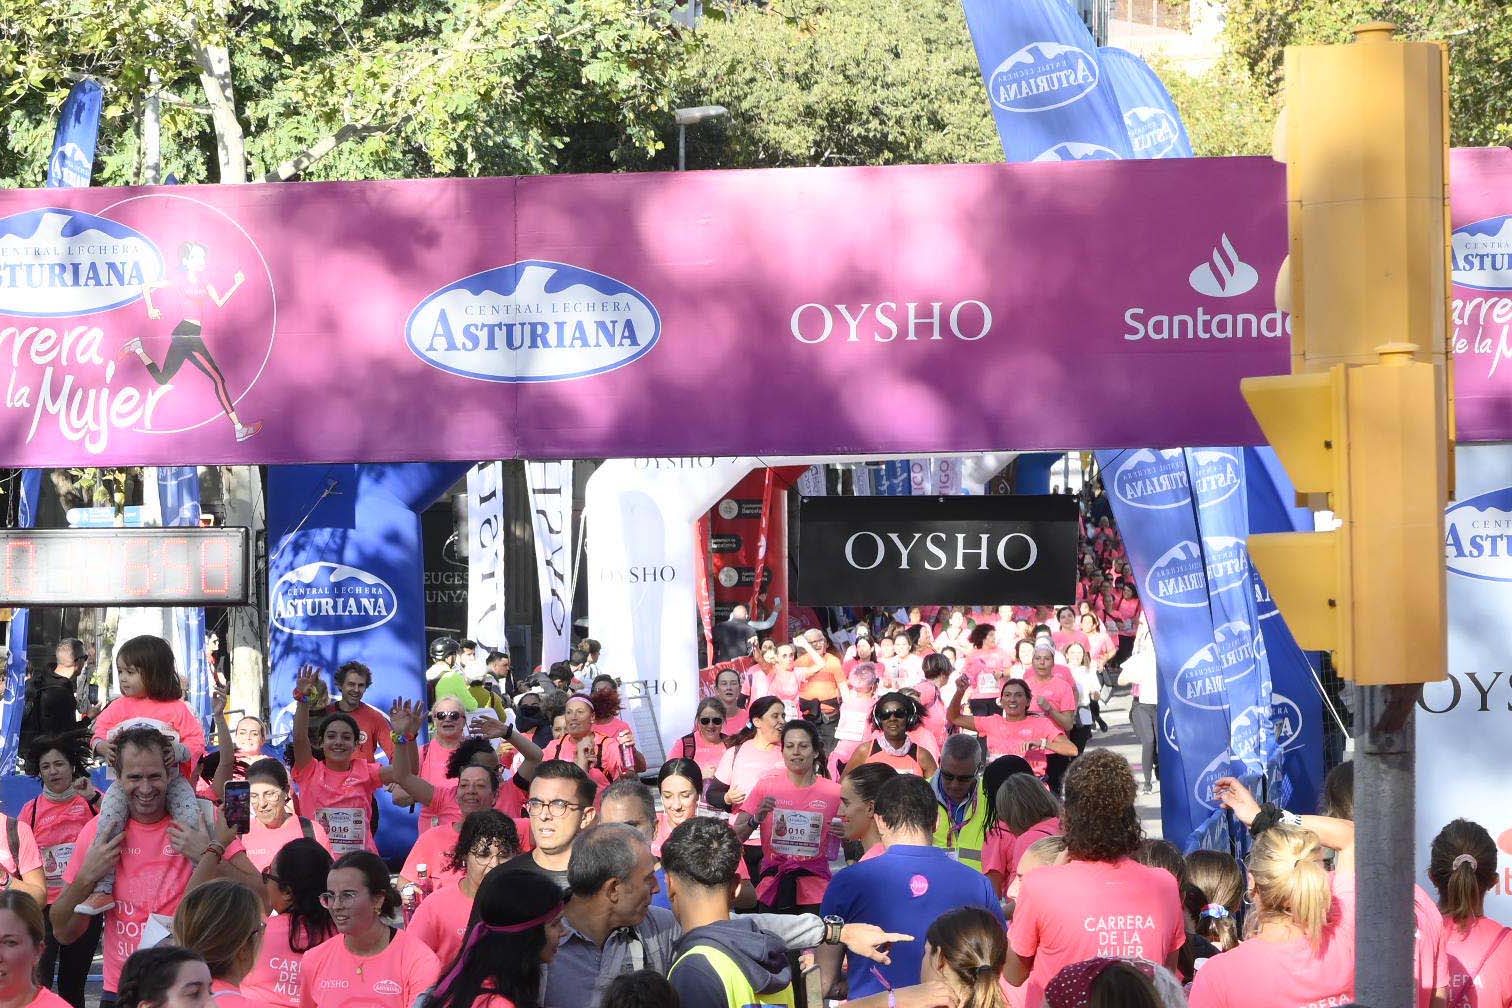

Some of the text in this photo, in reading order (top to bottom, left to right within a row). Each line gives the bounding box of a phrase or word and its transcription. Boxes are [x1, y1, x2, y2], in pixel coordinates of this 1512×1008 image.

[67, 244, 140, 257] LECHERA
[464, 300, 633, 316] CENTRAL LECHERA
[425, 307, 642, 353] ASTURIANA
[790, 299, 993, 345] OYSHO
[1474, 325, 1493, 355] la
[5, 367, 31, 409] la
[25, 361, 175, 455] Mujer
[844, 530, 1039, 572] OYSHO
[288, 586, 383, 596] CENTRAL LECHERA
[274, 591, 388, 619] ASTURIANA
[788, 827, 805, 835] 016
[116, 900, 134, 916] TU
[1084, 914, 1156, 932] CARRERA
[1100, 930, 1142, 946] DE LA
[280, 972, 297, 984] DE
[320, 980, 349, 989] OYSHO
